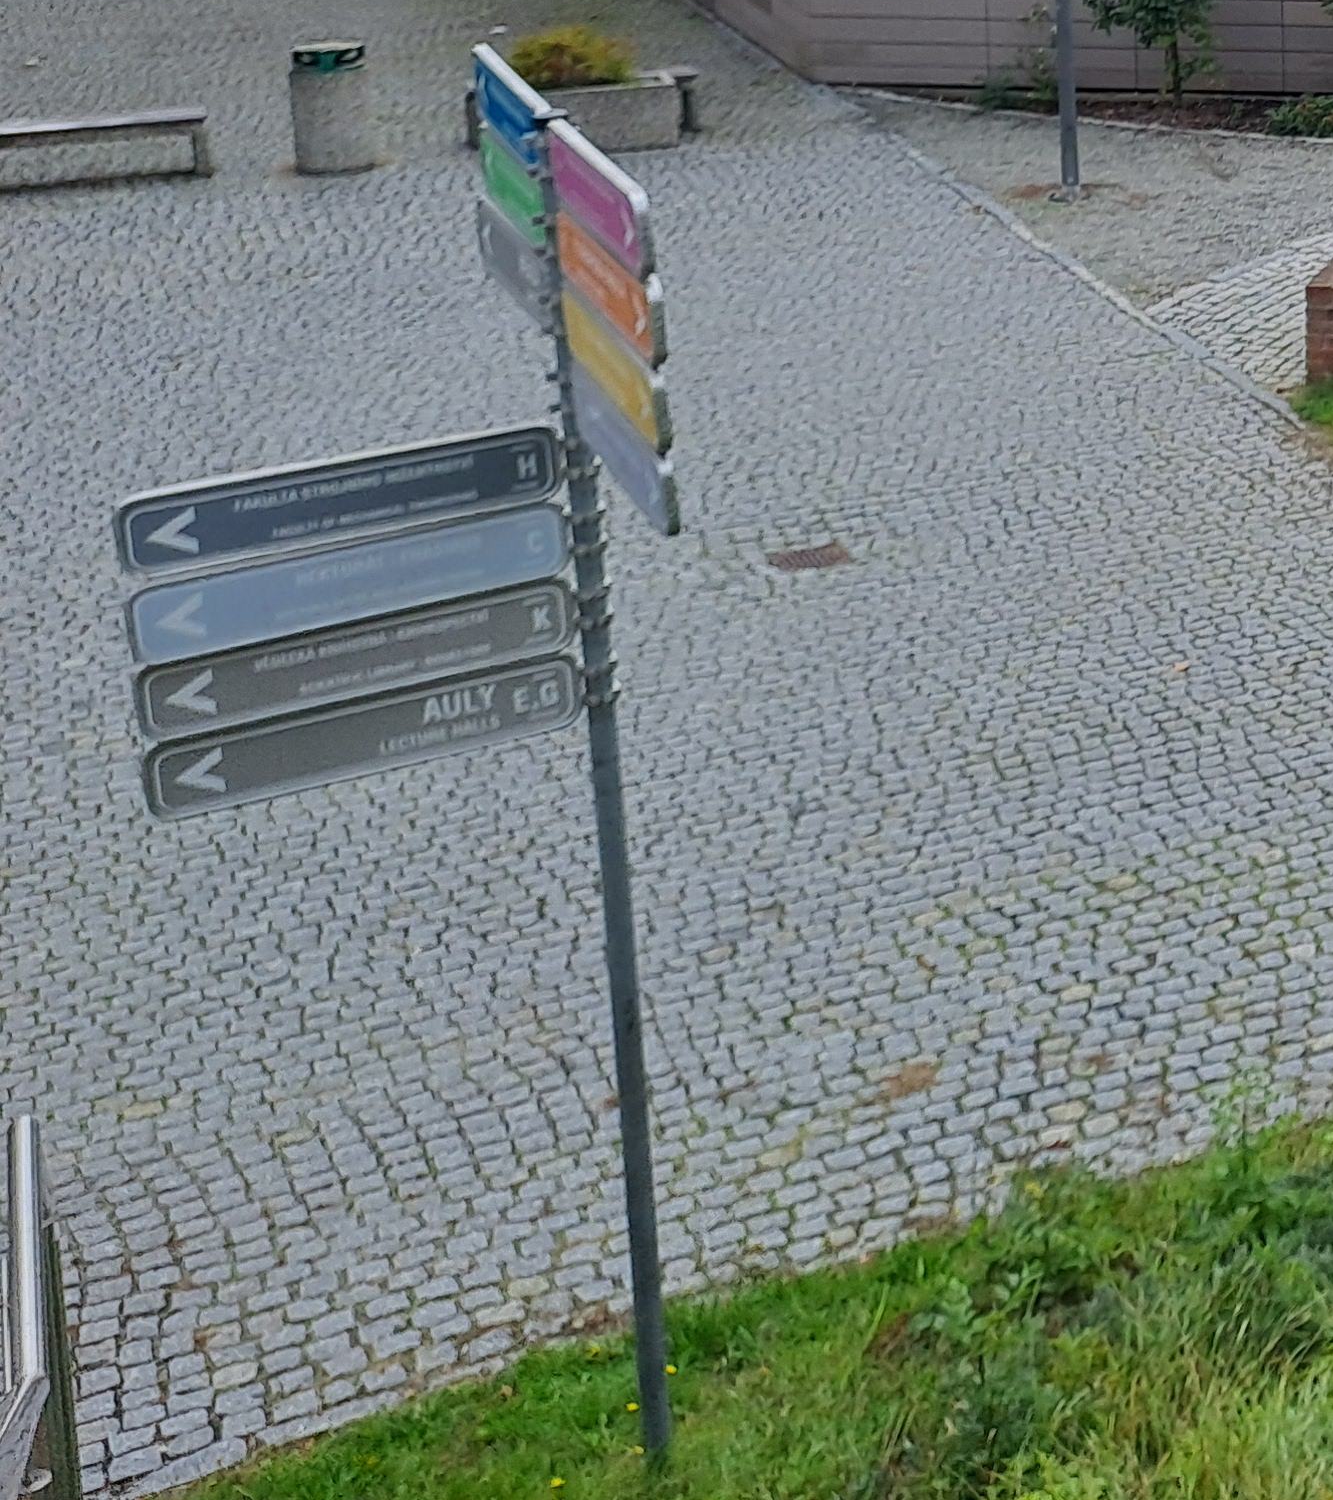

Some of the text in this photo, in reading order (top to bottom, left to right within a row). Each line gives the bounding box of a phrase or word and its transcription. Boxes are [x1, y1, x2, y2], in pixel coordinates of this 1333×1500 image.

[516, 452, 537, 480] H
[532, 604, 552, 633] K
[423, 683, 497, 725] AULY
